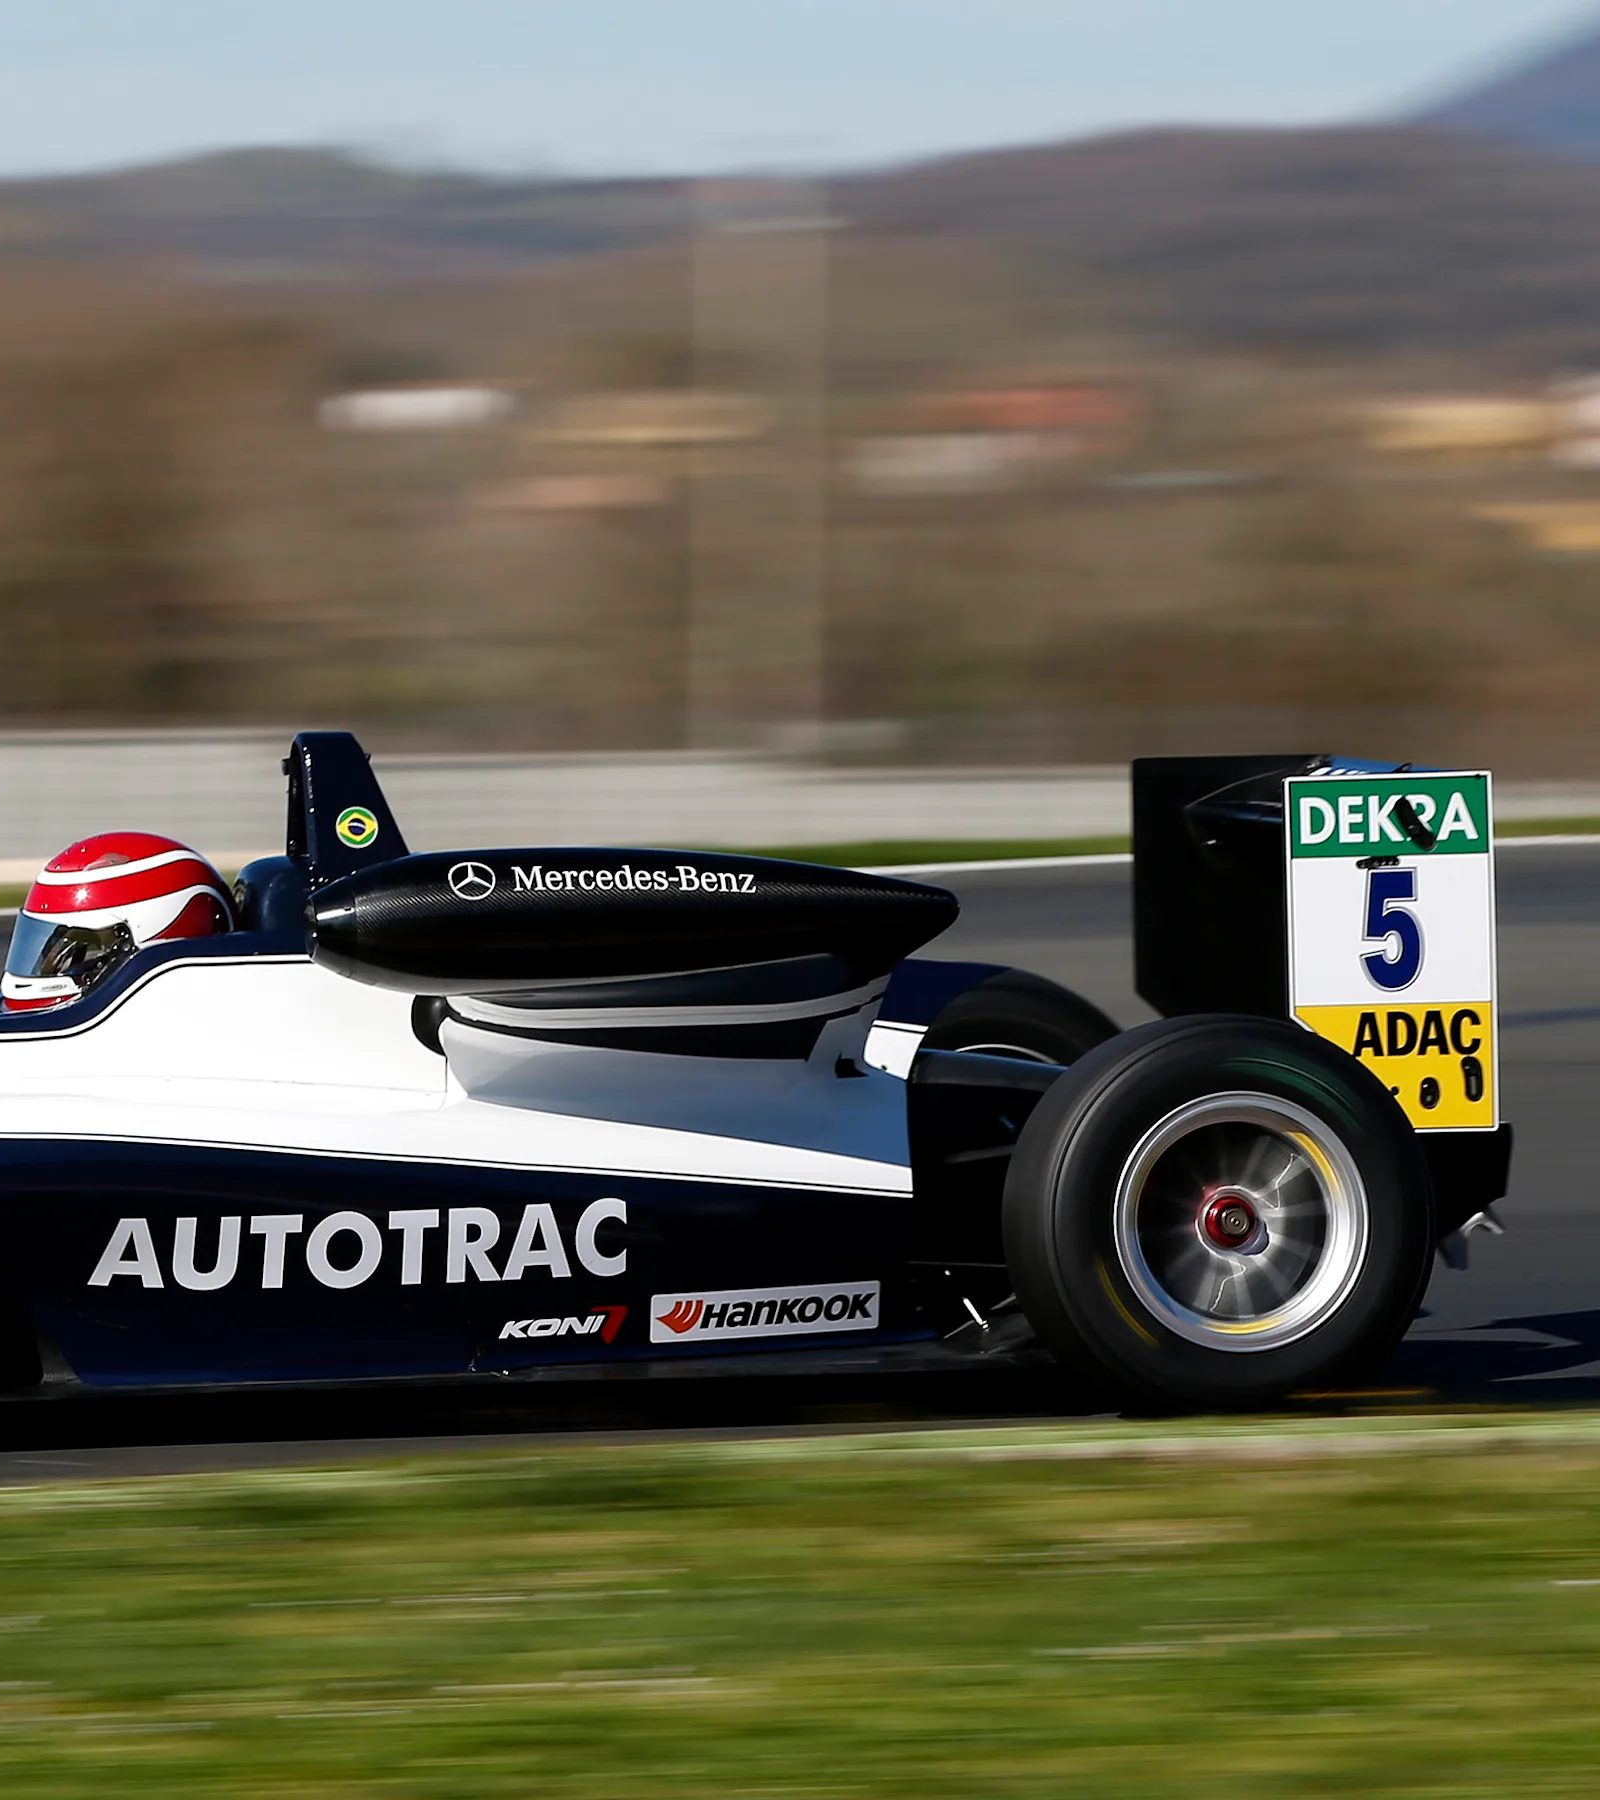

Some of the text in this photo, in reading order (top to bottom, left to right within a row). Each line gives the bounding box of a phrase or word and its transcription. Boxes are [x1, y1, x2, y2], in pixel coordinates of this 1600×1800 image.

[510, 864, 758, 894] Mercedes-Benz
[1359, 867, 1426, 992] 5
[1352, 1008, 1482, 1057] ADAC
[86, 1197, 628, 1291] AUTOTRAC
[498, 1314, 606, 1340] KONI
